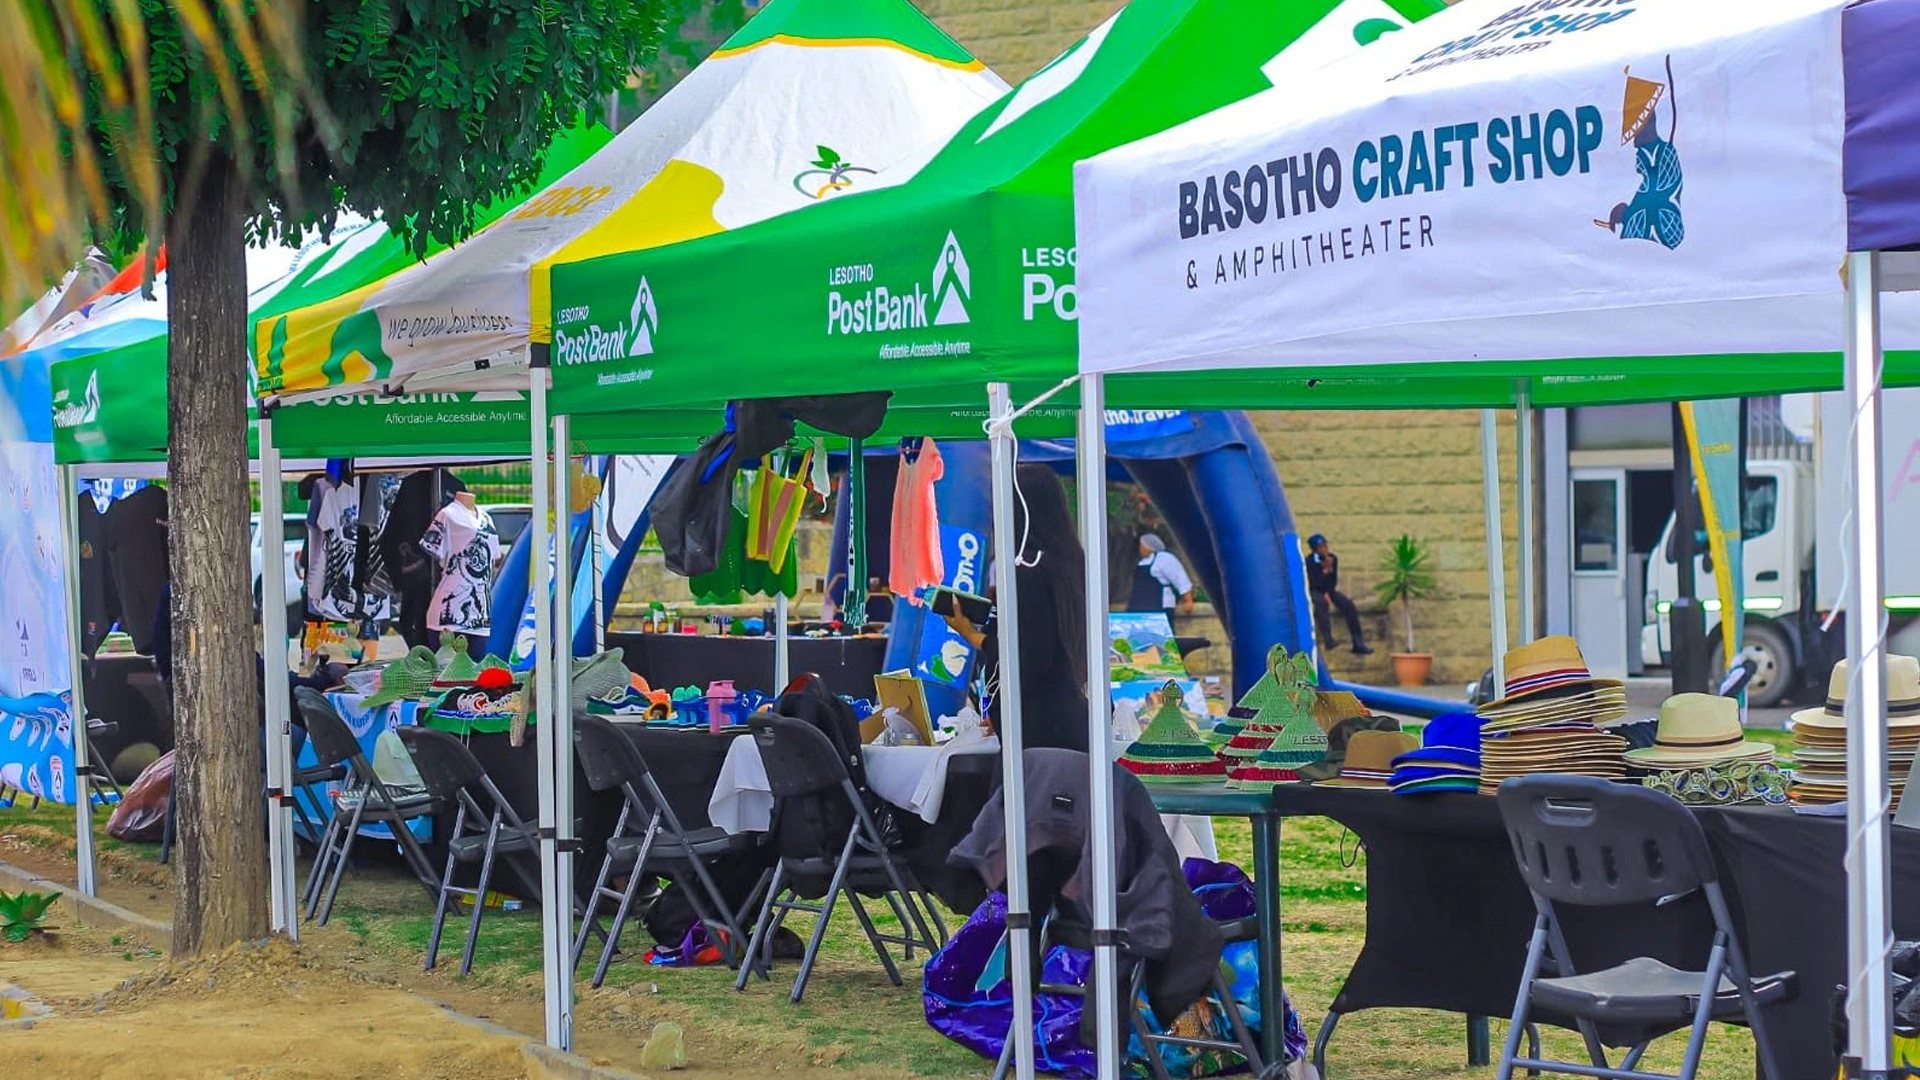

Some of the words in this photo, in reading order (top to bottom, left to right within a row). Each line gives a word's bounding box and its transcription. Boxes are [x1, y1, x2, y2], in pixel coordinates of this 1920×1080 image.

[1512, 8, 1637, 38] SHOP
[1179, 147, 1342, 240] BASOTHO
[1353, 122, 1479, 204] CRAFT
[1487, 105, 1603, 184] SHOP
[829, 263, 874, 286] LESOTHO
[1186, 259, 1198, 289] &
[1215, 215, 1434, 285] AMPHITHEATER
[557, 305, 590, 325] LESOTHO
[827, 282, 929, 335] PostBank
[556, 320, 629, 366] PostBank
